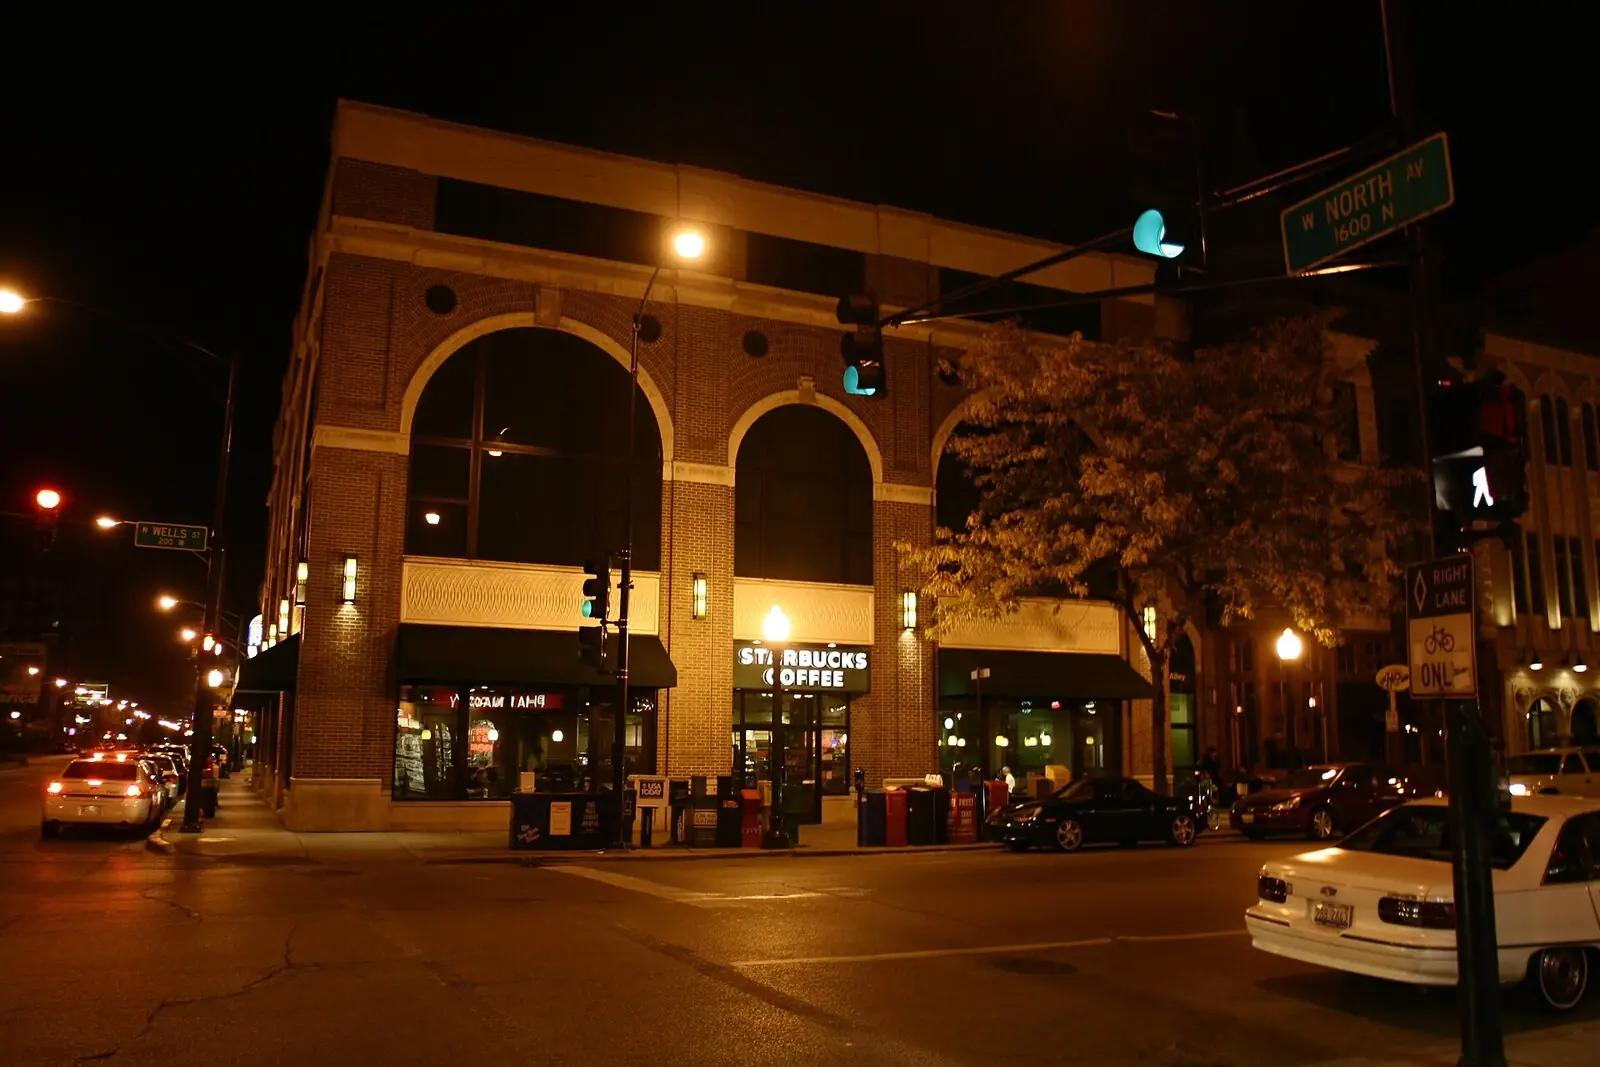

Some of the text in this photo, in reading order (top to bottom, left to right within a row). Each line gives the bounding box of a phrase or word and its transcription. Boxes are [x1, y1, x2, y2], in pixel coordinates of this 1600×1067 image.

[1301, 158, 1424, 232] W NORTH AV
[1333, 202, 1394, 244] 1600 N
[142, 526, 148, 534] N
[152, 526, 187, 538] WELLS
[1434, 564, 1468, 584] RIGHT
[1435, 589, 1466, 608] LANE
[762, 667, 844, 687] COFFEE
